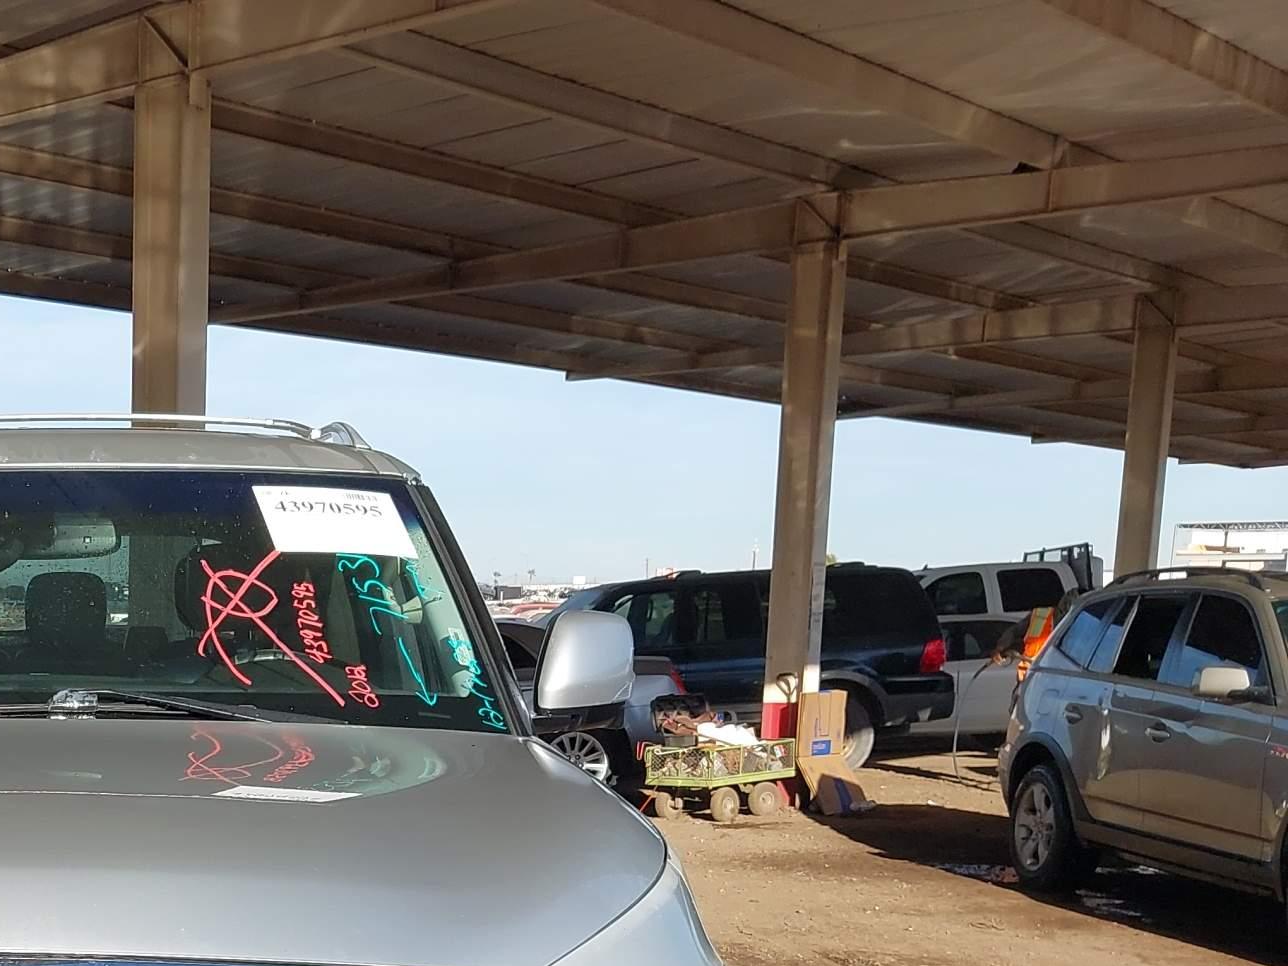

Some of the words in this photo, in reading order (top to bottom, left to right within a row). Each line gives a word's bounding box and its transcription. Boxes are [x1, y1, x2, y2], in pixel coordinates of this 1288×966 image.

[274, 499, 383, 517] 43970595
[290, 581, 333, 664] 43970595
[344, 664, 381, 708] 2012
